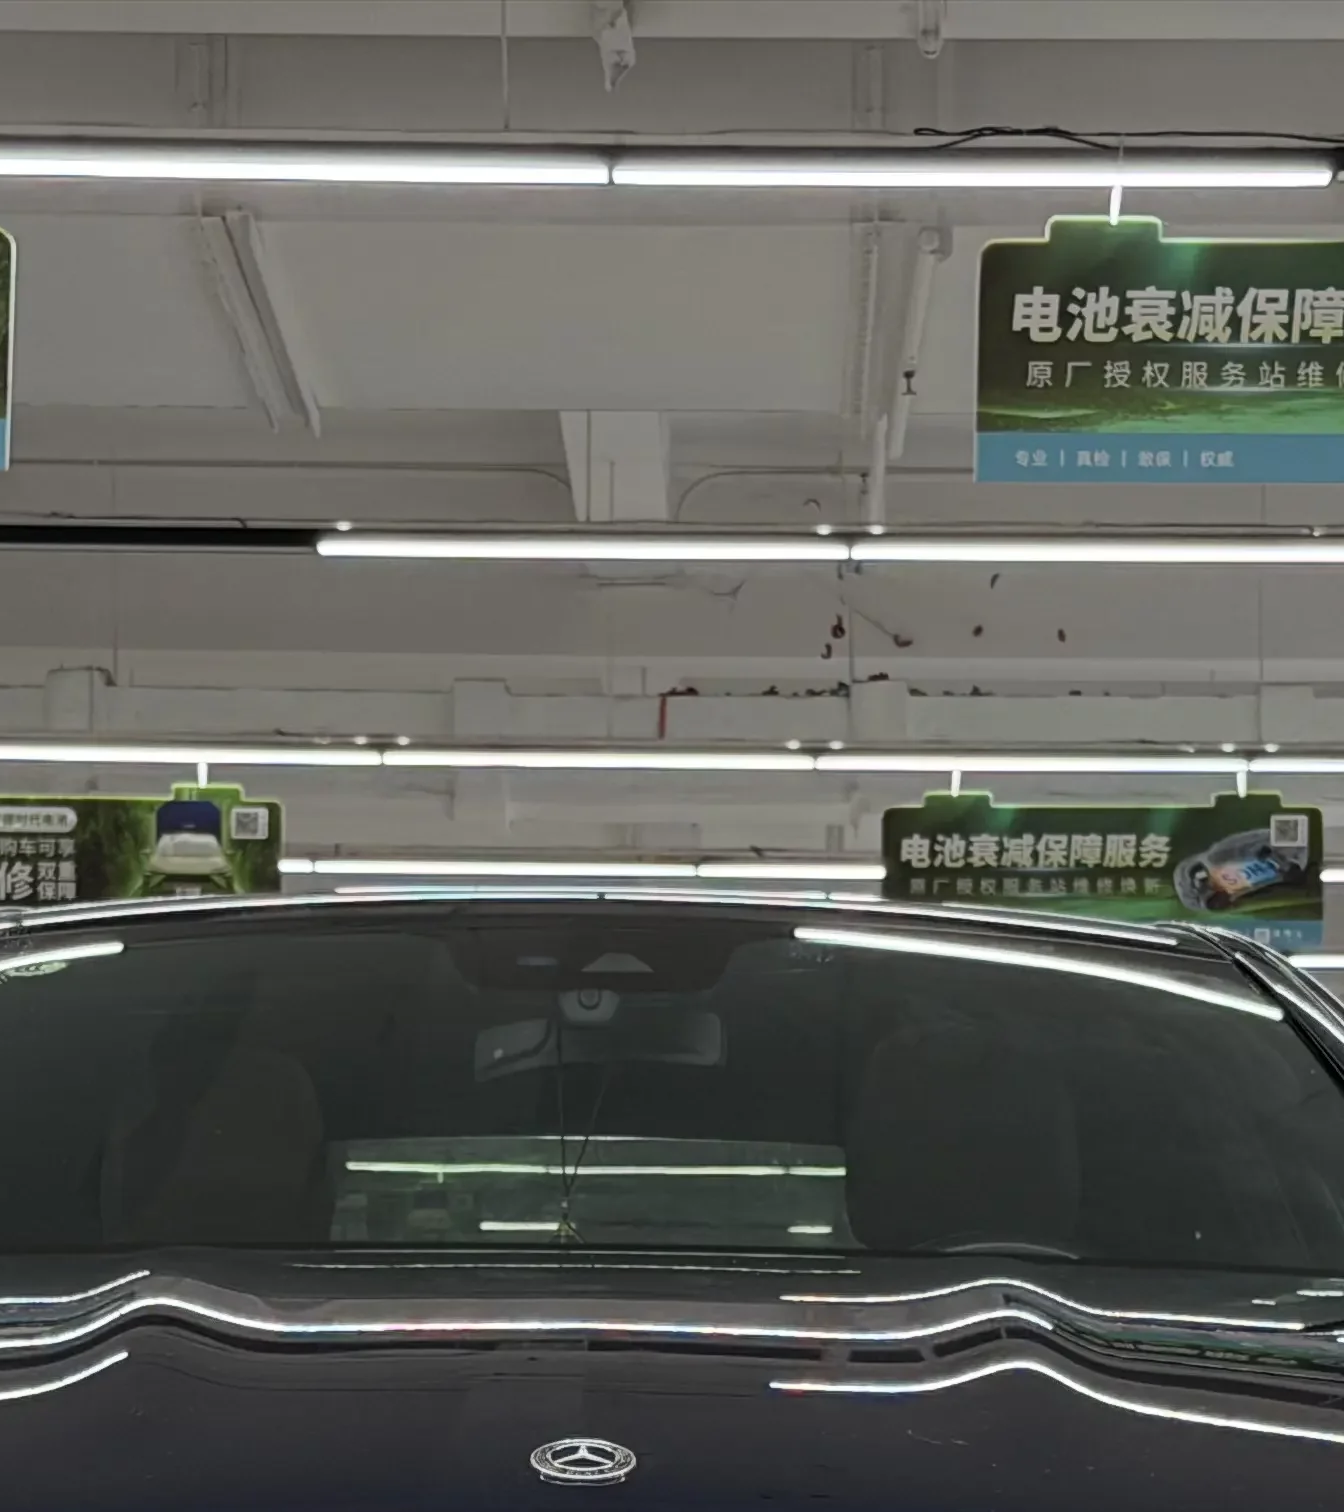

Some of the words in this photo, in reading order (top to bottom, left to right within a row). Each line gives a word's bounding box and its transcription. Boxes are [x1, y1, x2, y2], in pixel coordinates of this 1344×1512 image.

[900, 833, 1172, 869] 电池衰减保障服务
